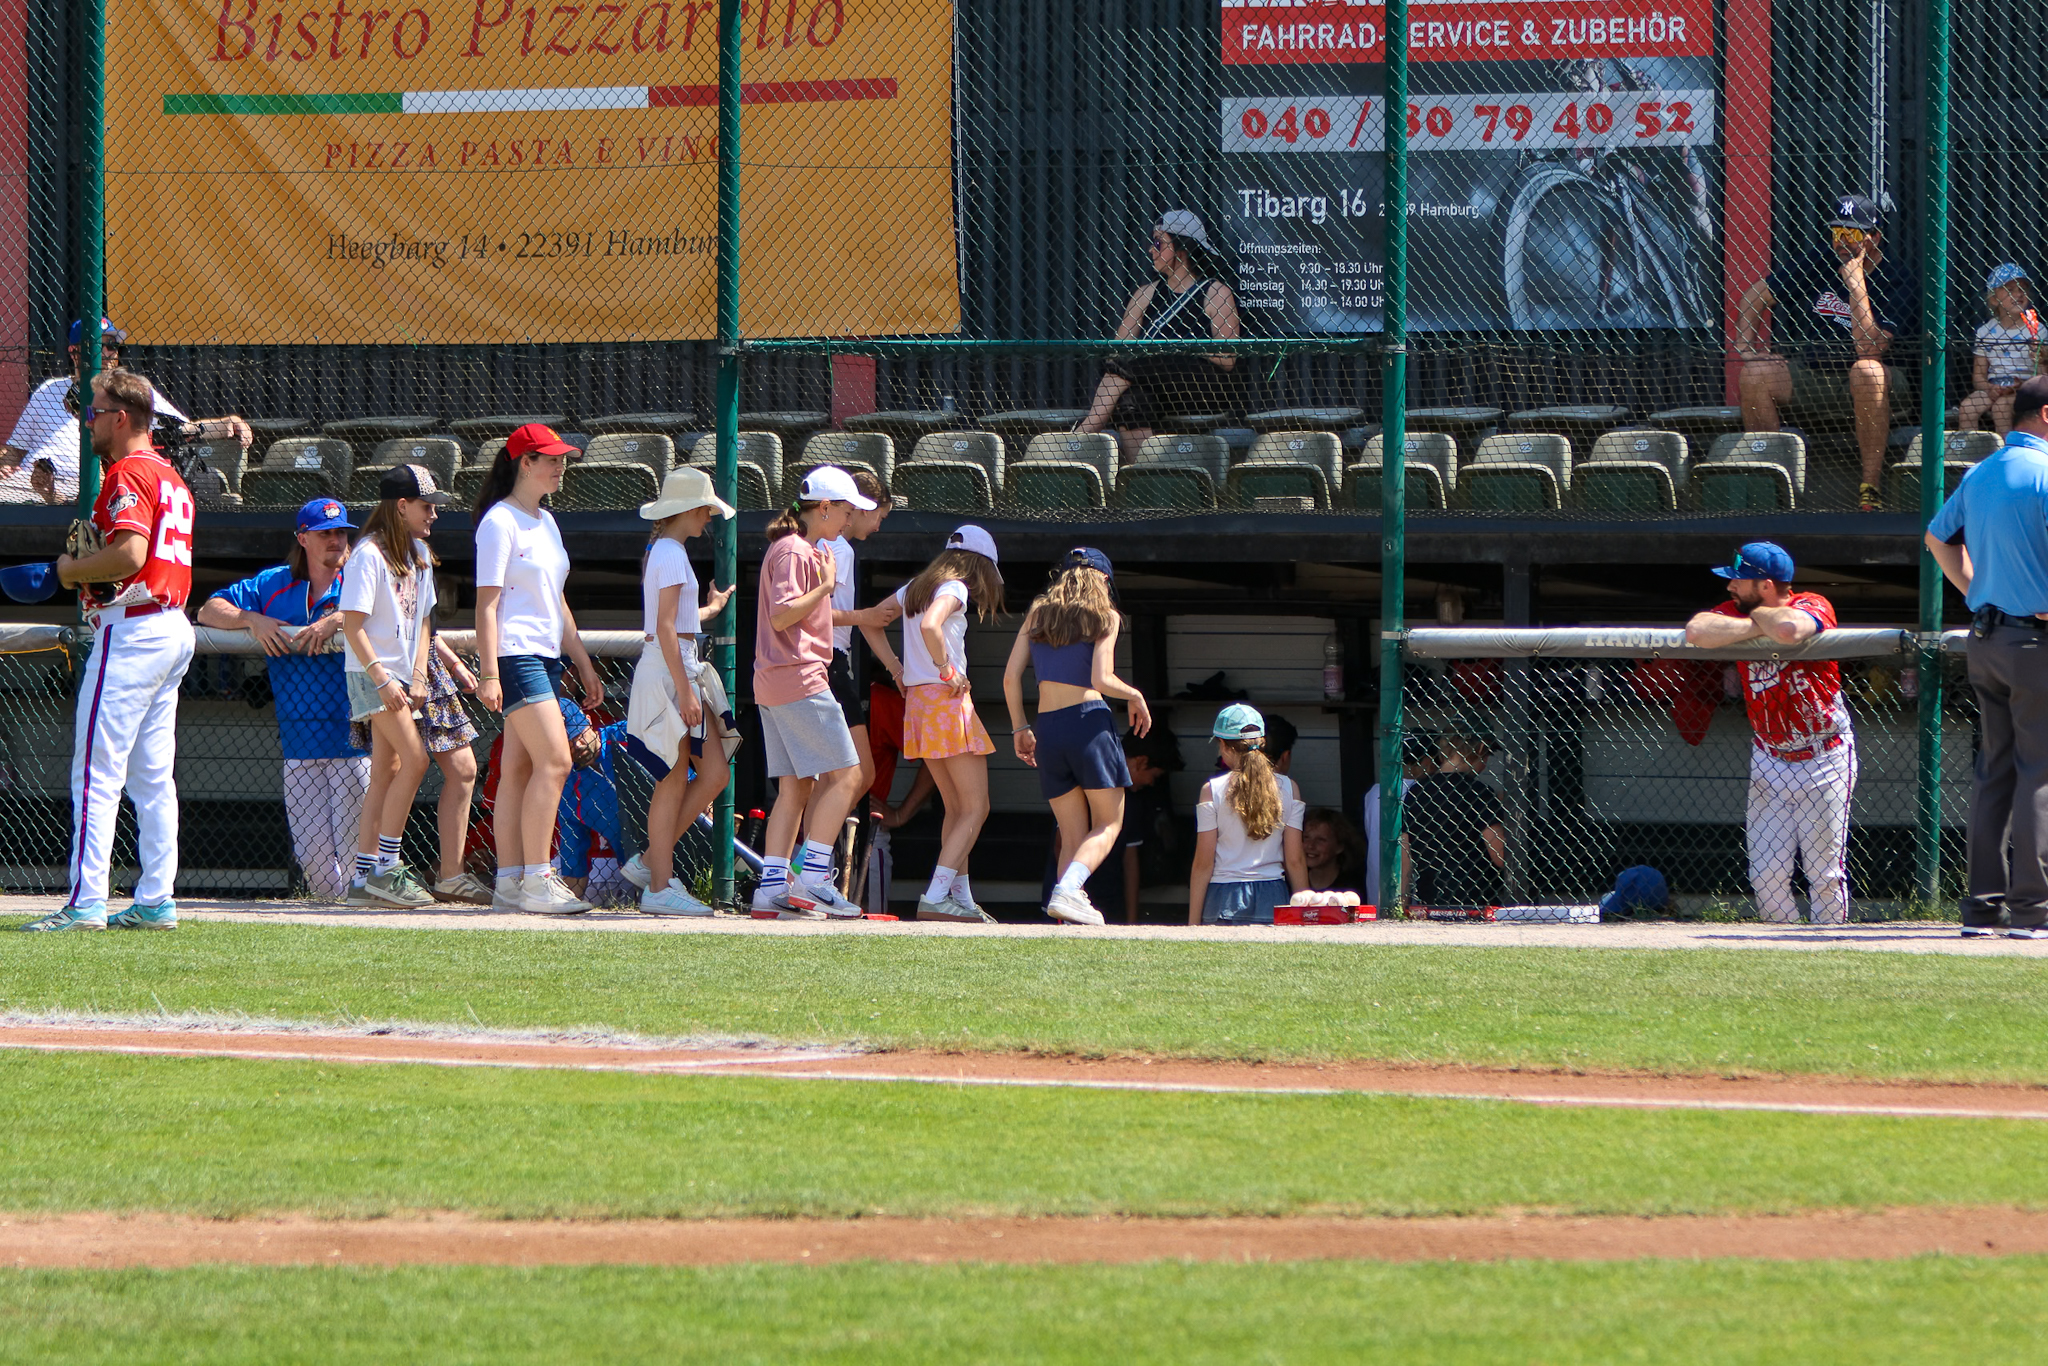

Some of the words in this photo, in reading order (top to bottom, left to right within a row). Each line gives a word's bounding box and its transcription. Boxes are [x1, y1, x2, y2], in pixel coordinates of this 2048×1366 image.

[207, 0, 431, 62] Bistro
[1551, 12, 1686, 45] ZUBEHÖR
[1241, 106, 1331, 143] 040
[1474, 104, 1533, 142] 79
[1552, 102, 1614, 139] 40
[1635, 101, 1695, 139] 52
[324, 142, 437, 169] PIZZA
[458, 139, 573, 166] PASTA
[594, 137, 614, 163] E
[1238, 189, 1327, 225] Tibarg
[1340, 188, 1367, 217] 16
[1420, 202, 1482, 218] Hamburg
[326, 232, 449, 270] Heegbarg
[458, 234, 489, 260] 14
[515, 231, 593, 259] 22391
[604, 226, 720, 258] Hambur
[1239, 242, 1322, 256] Öffnungszeiten:
[1239, 263, 1256, 274] Mo
[1267, 262, 1280, 274] Fr
[1299, 263, 1321, 274] 9.30
[1334, 262, 1361, 274] 18.30
[1364, 262, 1384, 274] Uhr
[1239, 280, 1285, 293] Dienstag
[1340, 279, 1367, 291] 19.30
[1369, 279, 1385, 291] Uh
[1239, 297, 1285, 310] Samstag
[1340, 296, 1368, 308] 14.00
[155, 479, 194, 567] 29
